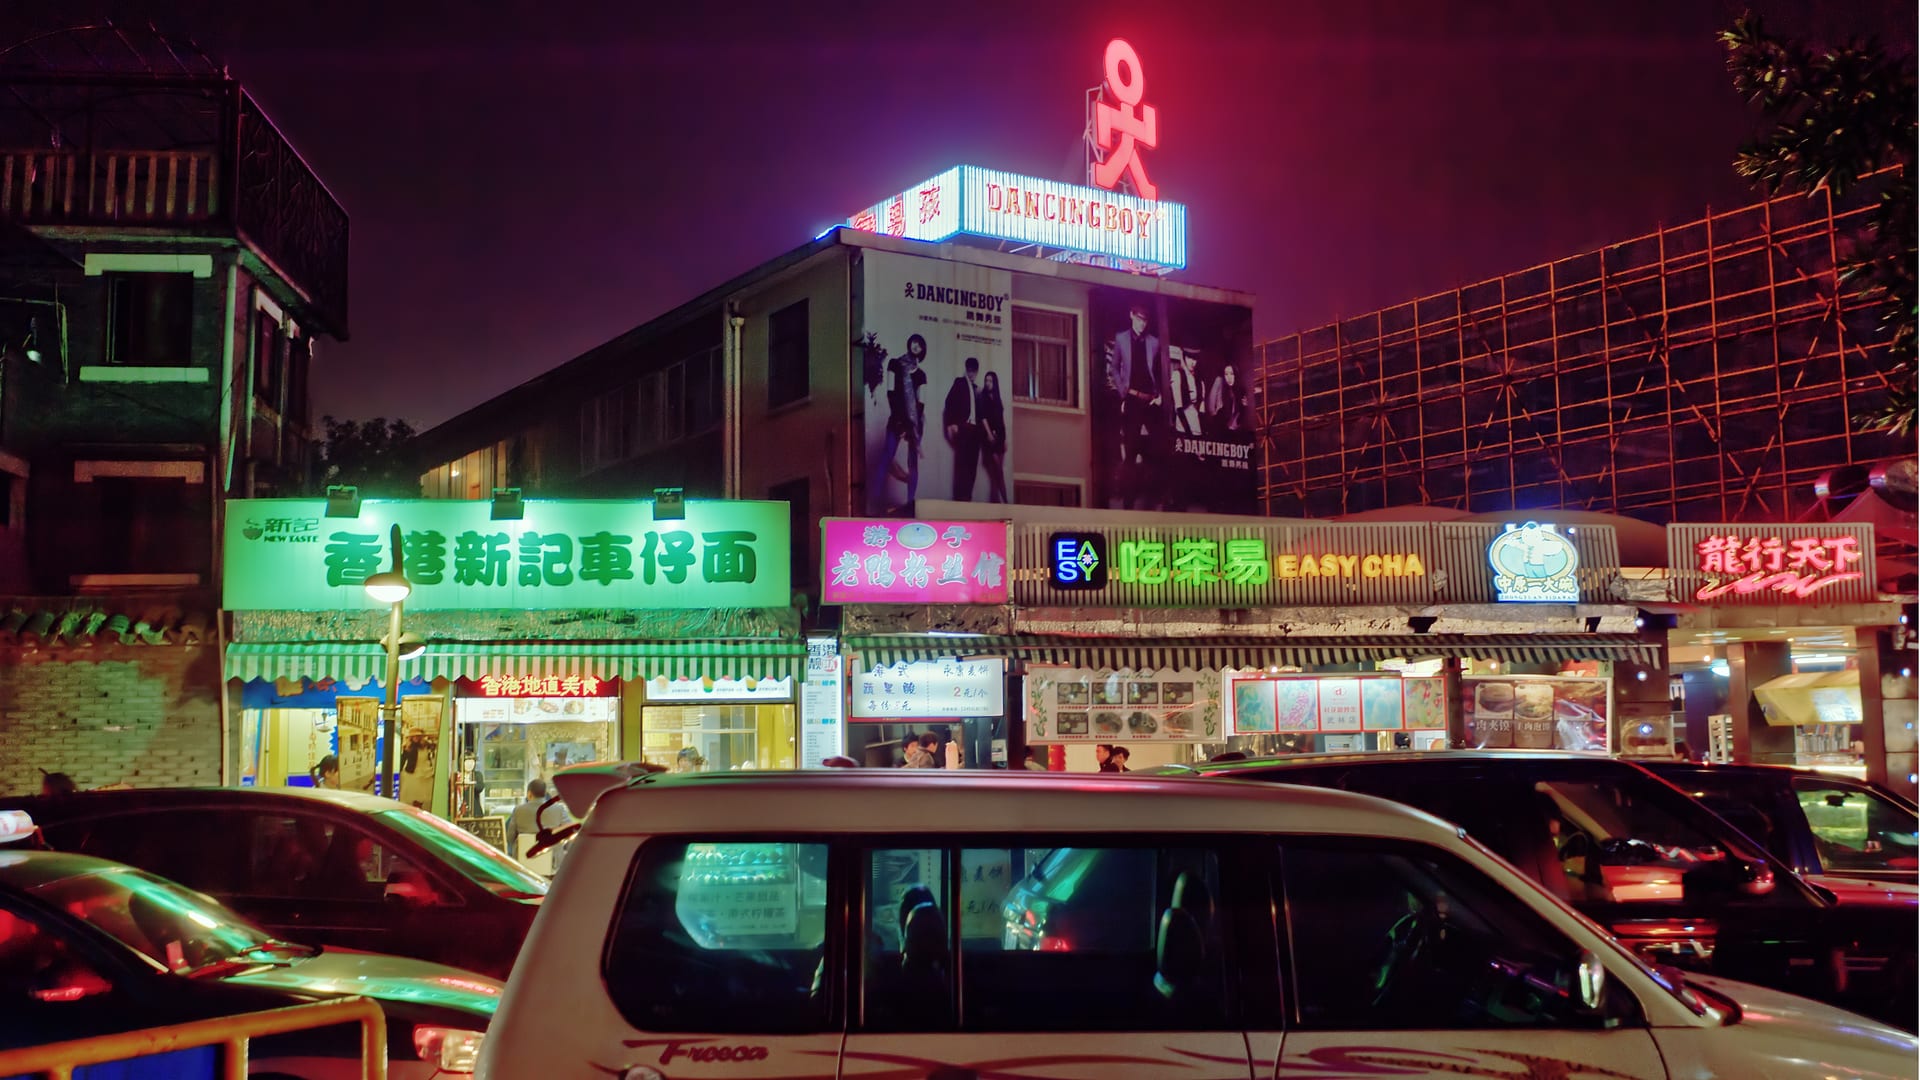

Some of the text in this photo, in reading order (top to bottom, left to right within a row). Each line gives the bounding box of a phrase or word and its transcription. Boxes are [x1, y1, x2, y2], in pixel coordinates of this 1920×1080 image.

[986, 182, 1152, 240] DANCINGBOY
[917, 283, 1004, 312] DANCINGBOY
[1184, 438, 1250, 459] DANCINGBOY
[264, 535, 319, 543] NEW TASTE
[1119, 540, 1269, 585] 吃茶易
[1278, 553, 1425, 579] EASY CHA
[1698, 534, 1862, 573] 龍行天下
[481, 675, 600, 697] 香港地道美食
